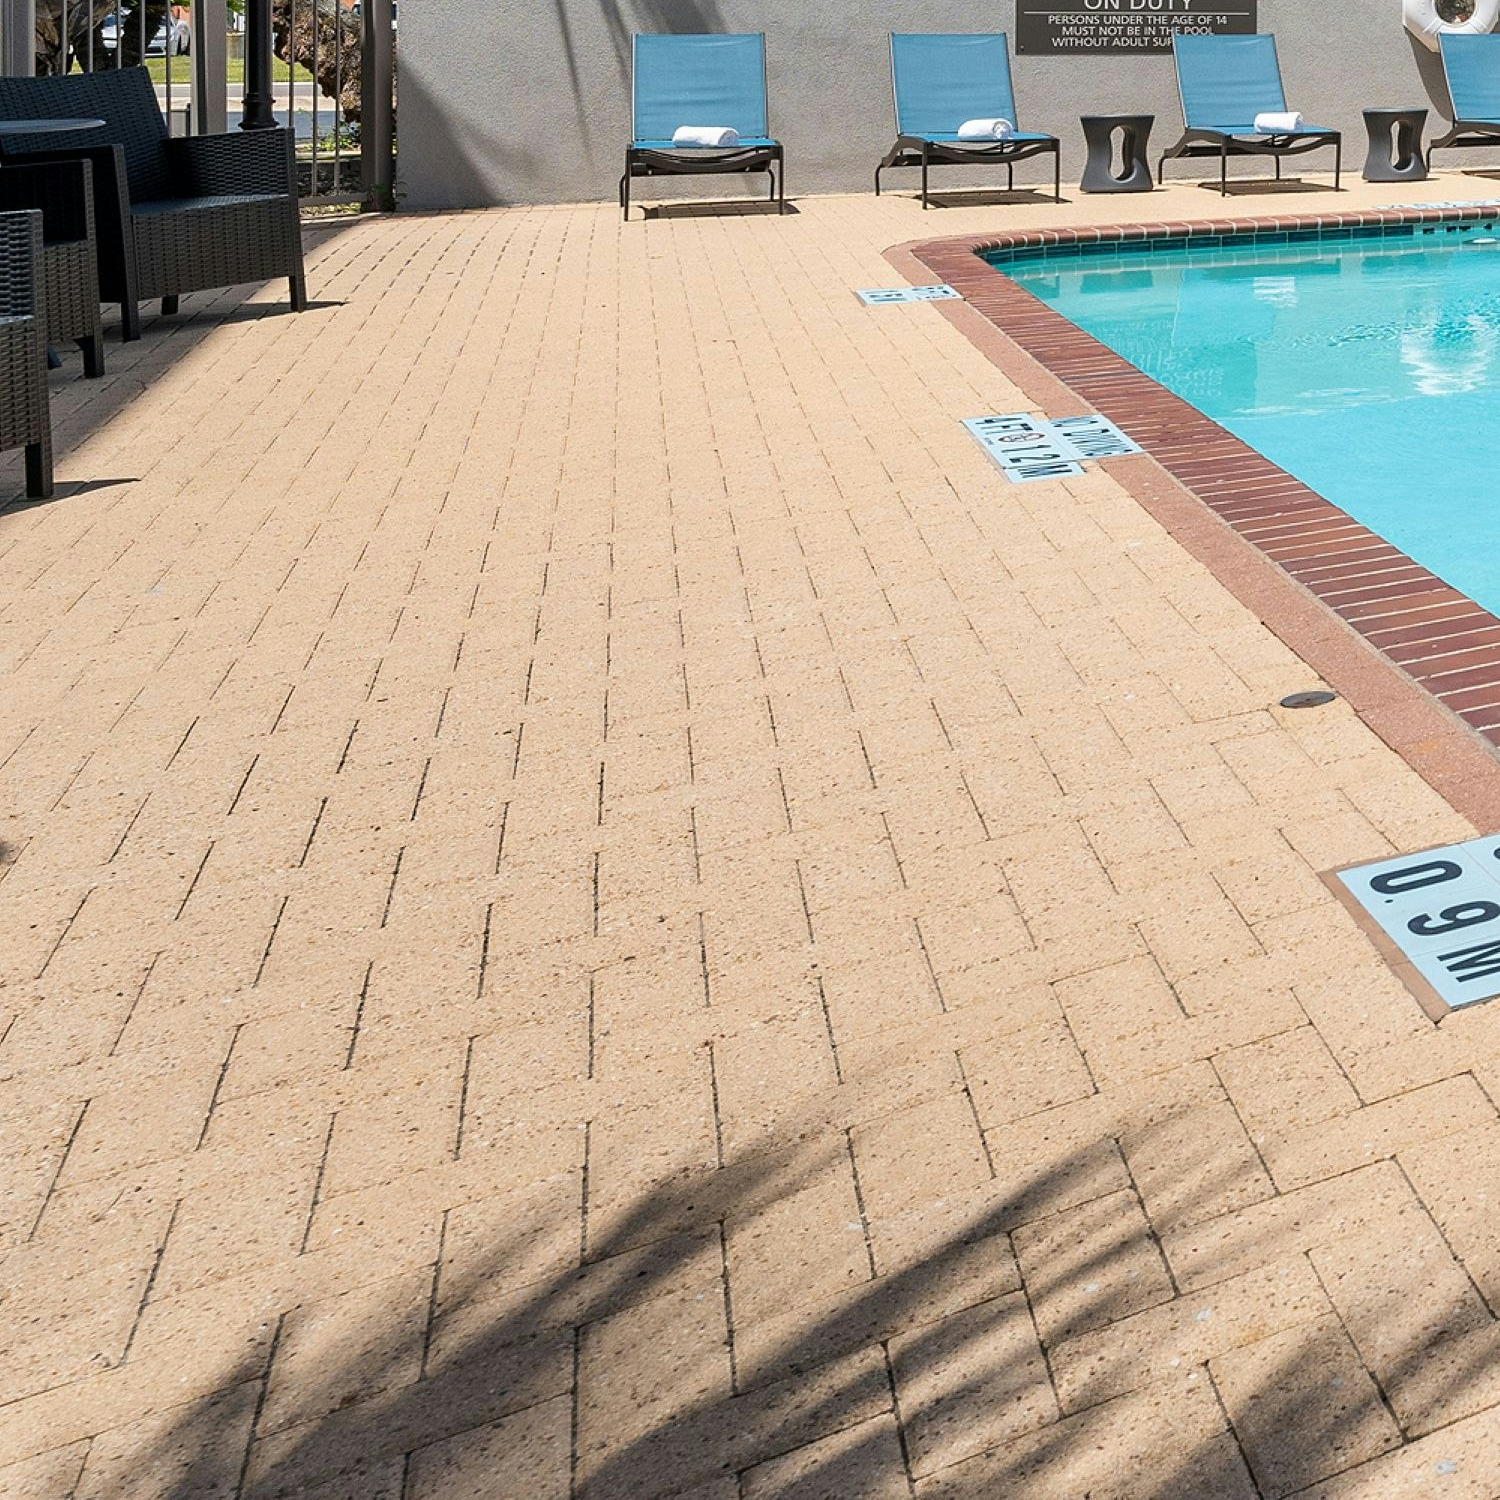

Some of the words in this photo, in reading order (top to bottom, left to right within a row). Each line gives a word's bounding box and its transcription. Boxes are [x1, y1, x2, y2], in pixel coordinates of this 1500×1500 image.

[1048, 16, 1100, 25] PERSONS
[1103, 16, 1144, 25] UNDER
[1148, 16, 1167, 25] THE
[1171, 16, 1193, 25] AGE
[1198, 16, 1212, 25] OF
[1216, 16, 1227, 25] 14
[1062, 26, 1094, 36] MUST
[1099, 26, 1123, 36] NOT
[1128, 26, 1140, 35] BE
[1144, 26, 1155, 35] IN
[1159, 26, 1180, 36] THE
[1184, 26, 1214, 36] POOL
[1052, 37, 1108, 47] WITHOUT
[1112, 37, 1148, 47] ADULT
